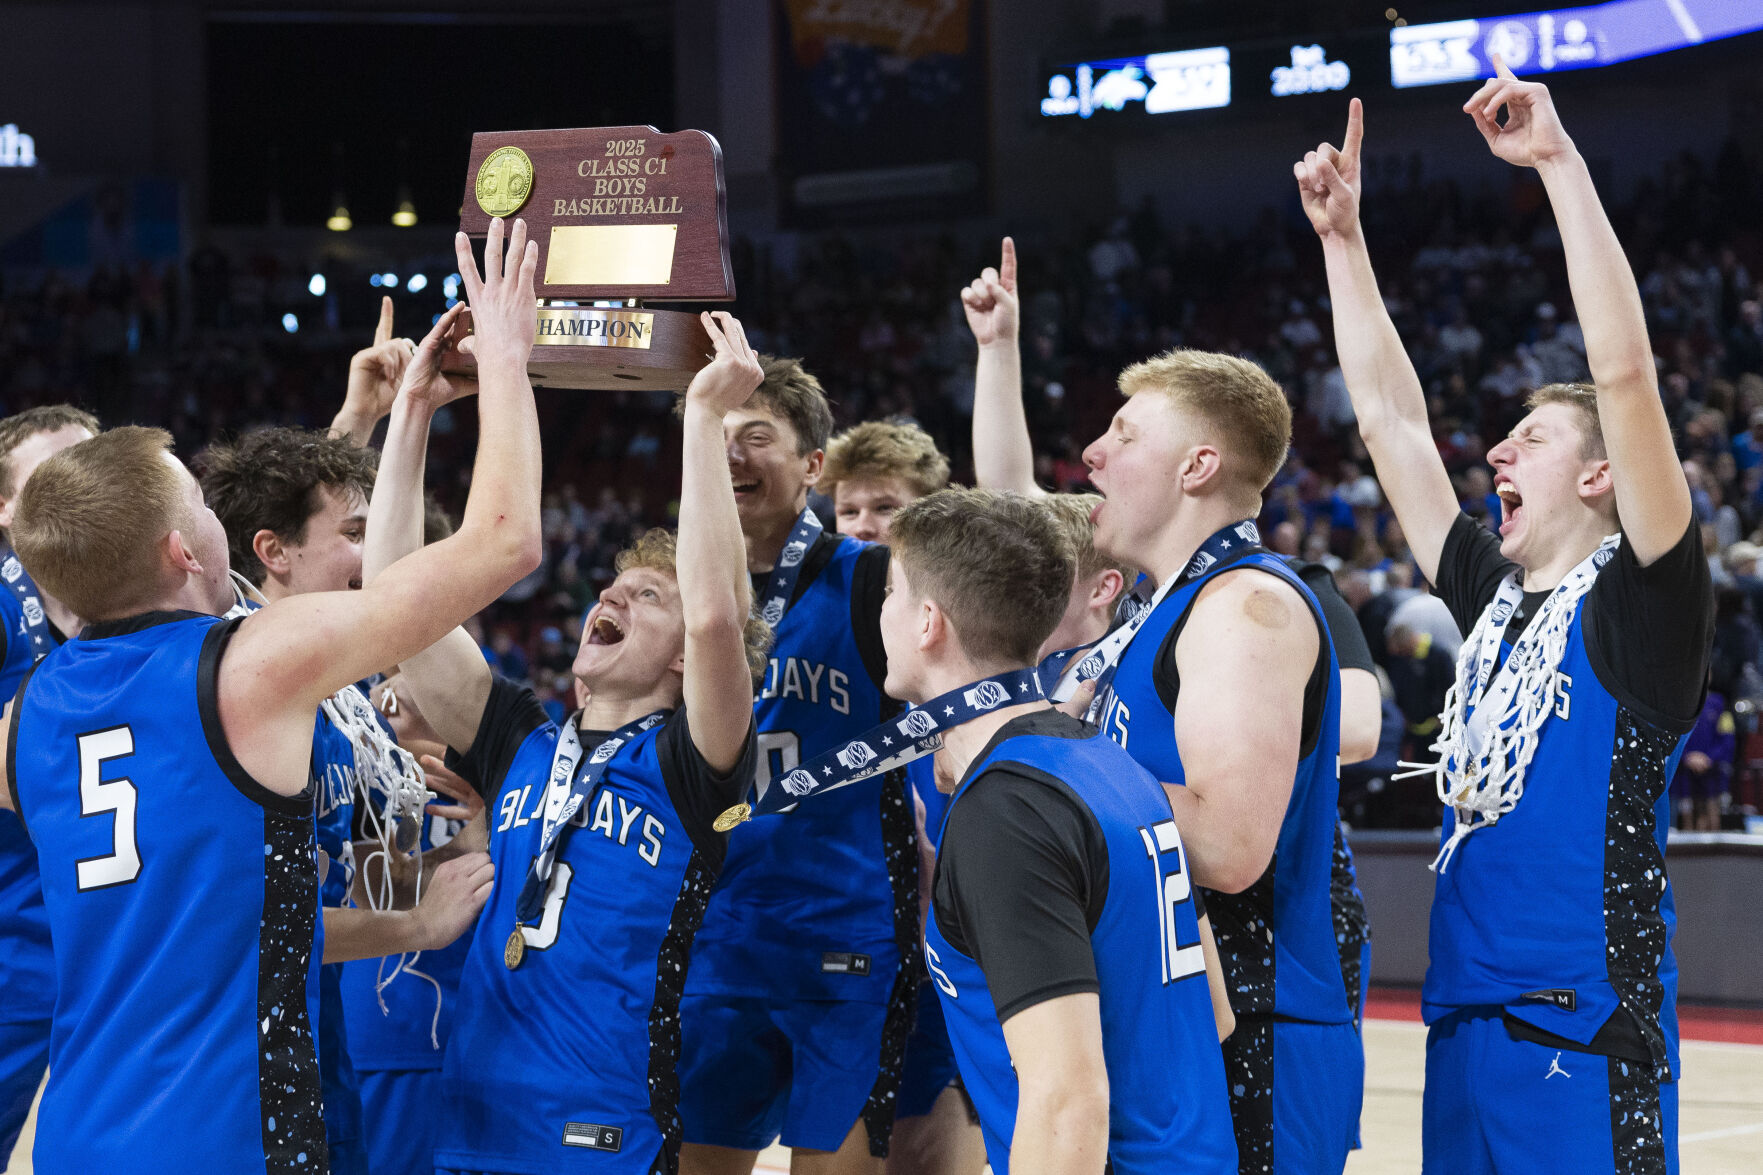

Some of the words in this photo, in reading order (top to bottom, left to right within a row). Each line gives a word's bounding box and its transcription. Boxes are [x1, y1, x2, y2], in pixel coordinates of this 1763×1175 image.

[604, 139, 646, 157] 2025
[577, 158, 641, 177] CLASS
[644, 157, 668, 175] C1
[594, 178, 647, 196] BOYS
[552, 197, 683, 216] BASKETBALL
[536, 317, 645, 340] HAMPION
[76, 724, 143, 892] 5
[497, 781, 666, 868] BLJAYS
[1138, 818, 1207, 987] 12
[855, 958, 865, 969] M
[1558, 995, 1568, 1005] M
[604, 1132, 613, 1144] S
